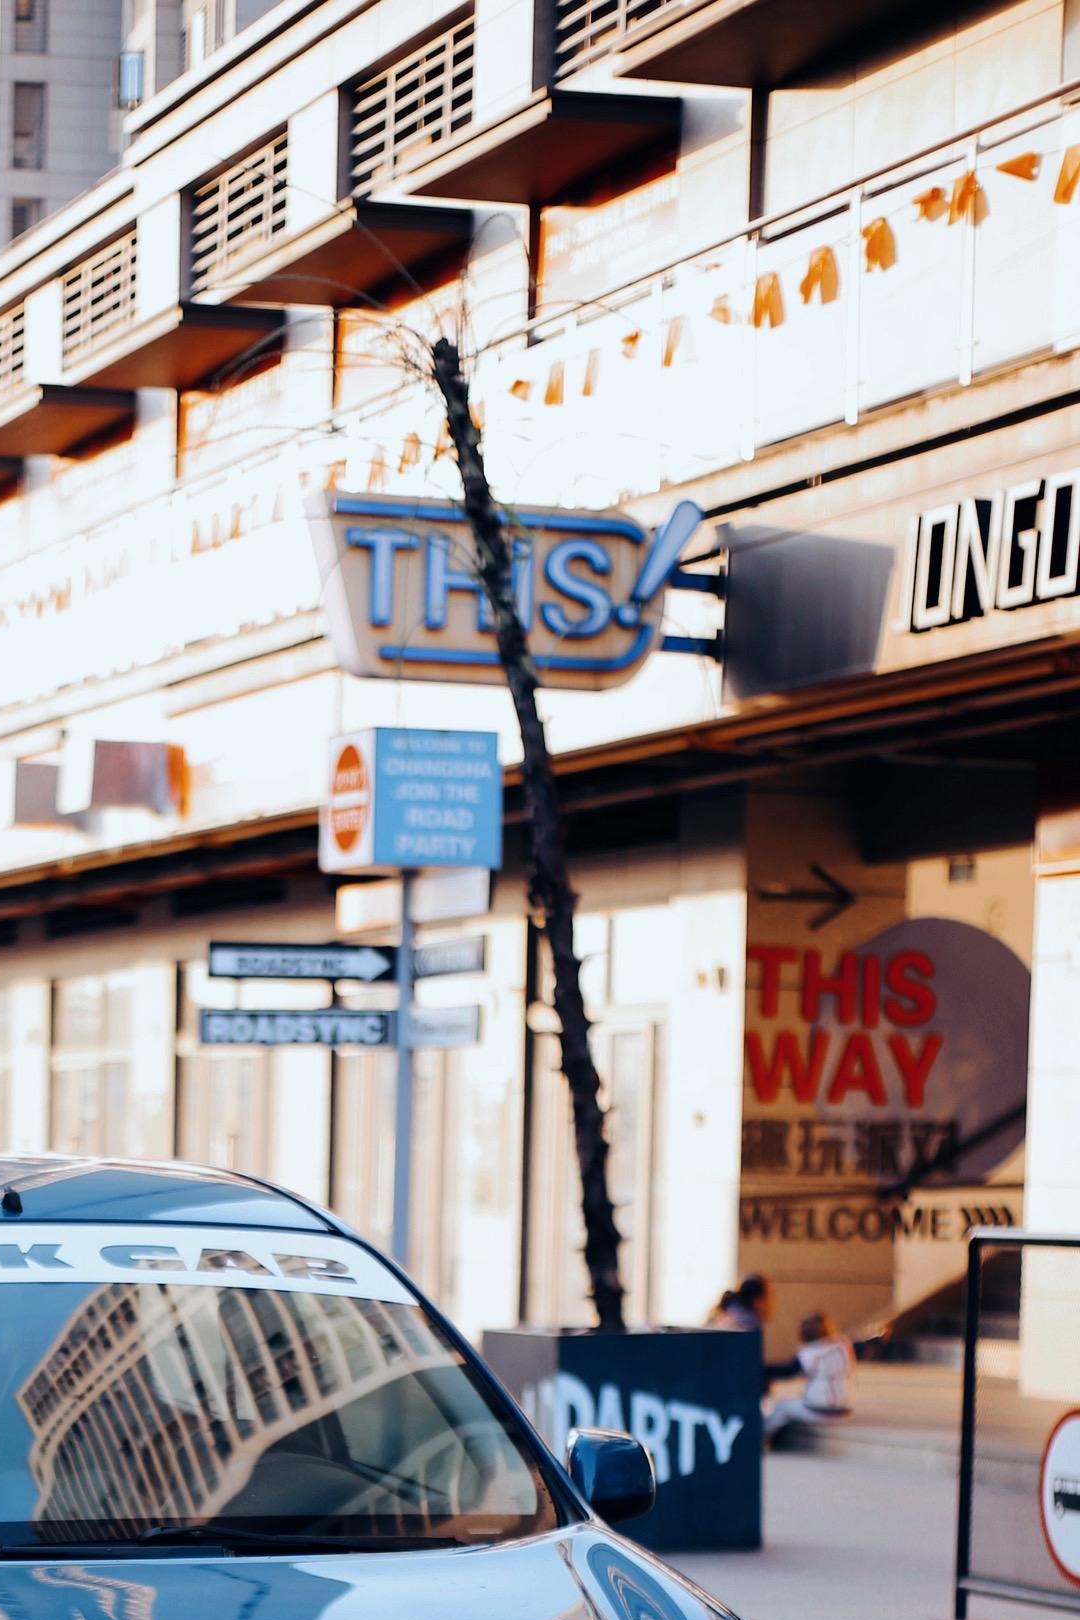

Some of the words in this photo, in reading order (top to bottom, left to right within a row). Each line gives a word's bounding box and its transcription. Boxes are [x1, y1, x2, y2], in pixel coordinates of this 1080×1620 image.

[383, 757, 493, 779] CHANGSHA
[396, 781, 441, 801] JOIN
[443, 783, 481, 803] THE
[405, 806, 474, 831] ROAD
[396, 832, 477, 858] PARTY
[747, 944, 937, 1030] THIS
[207, 1013, 384, 1044] ROADSYNC
[744, 1028, 945, 1109] WAY
[740, 1201, 957, 1241] WELCOME
[99, 1244, 358, 1285] CAR
